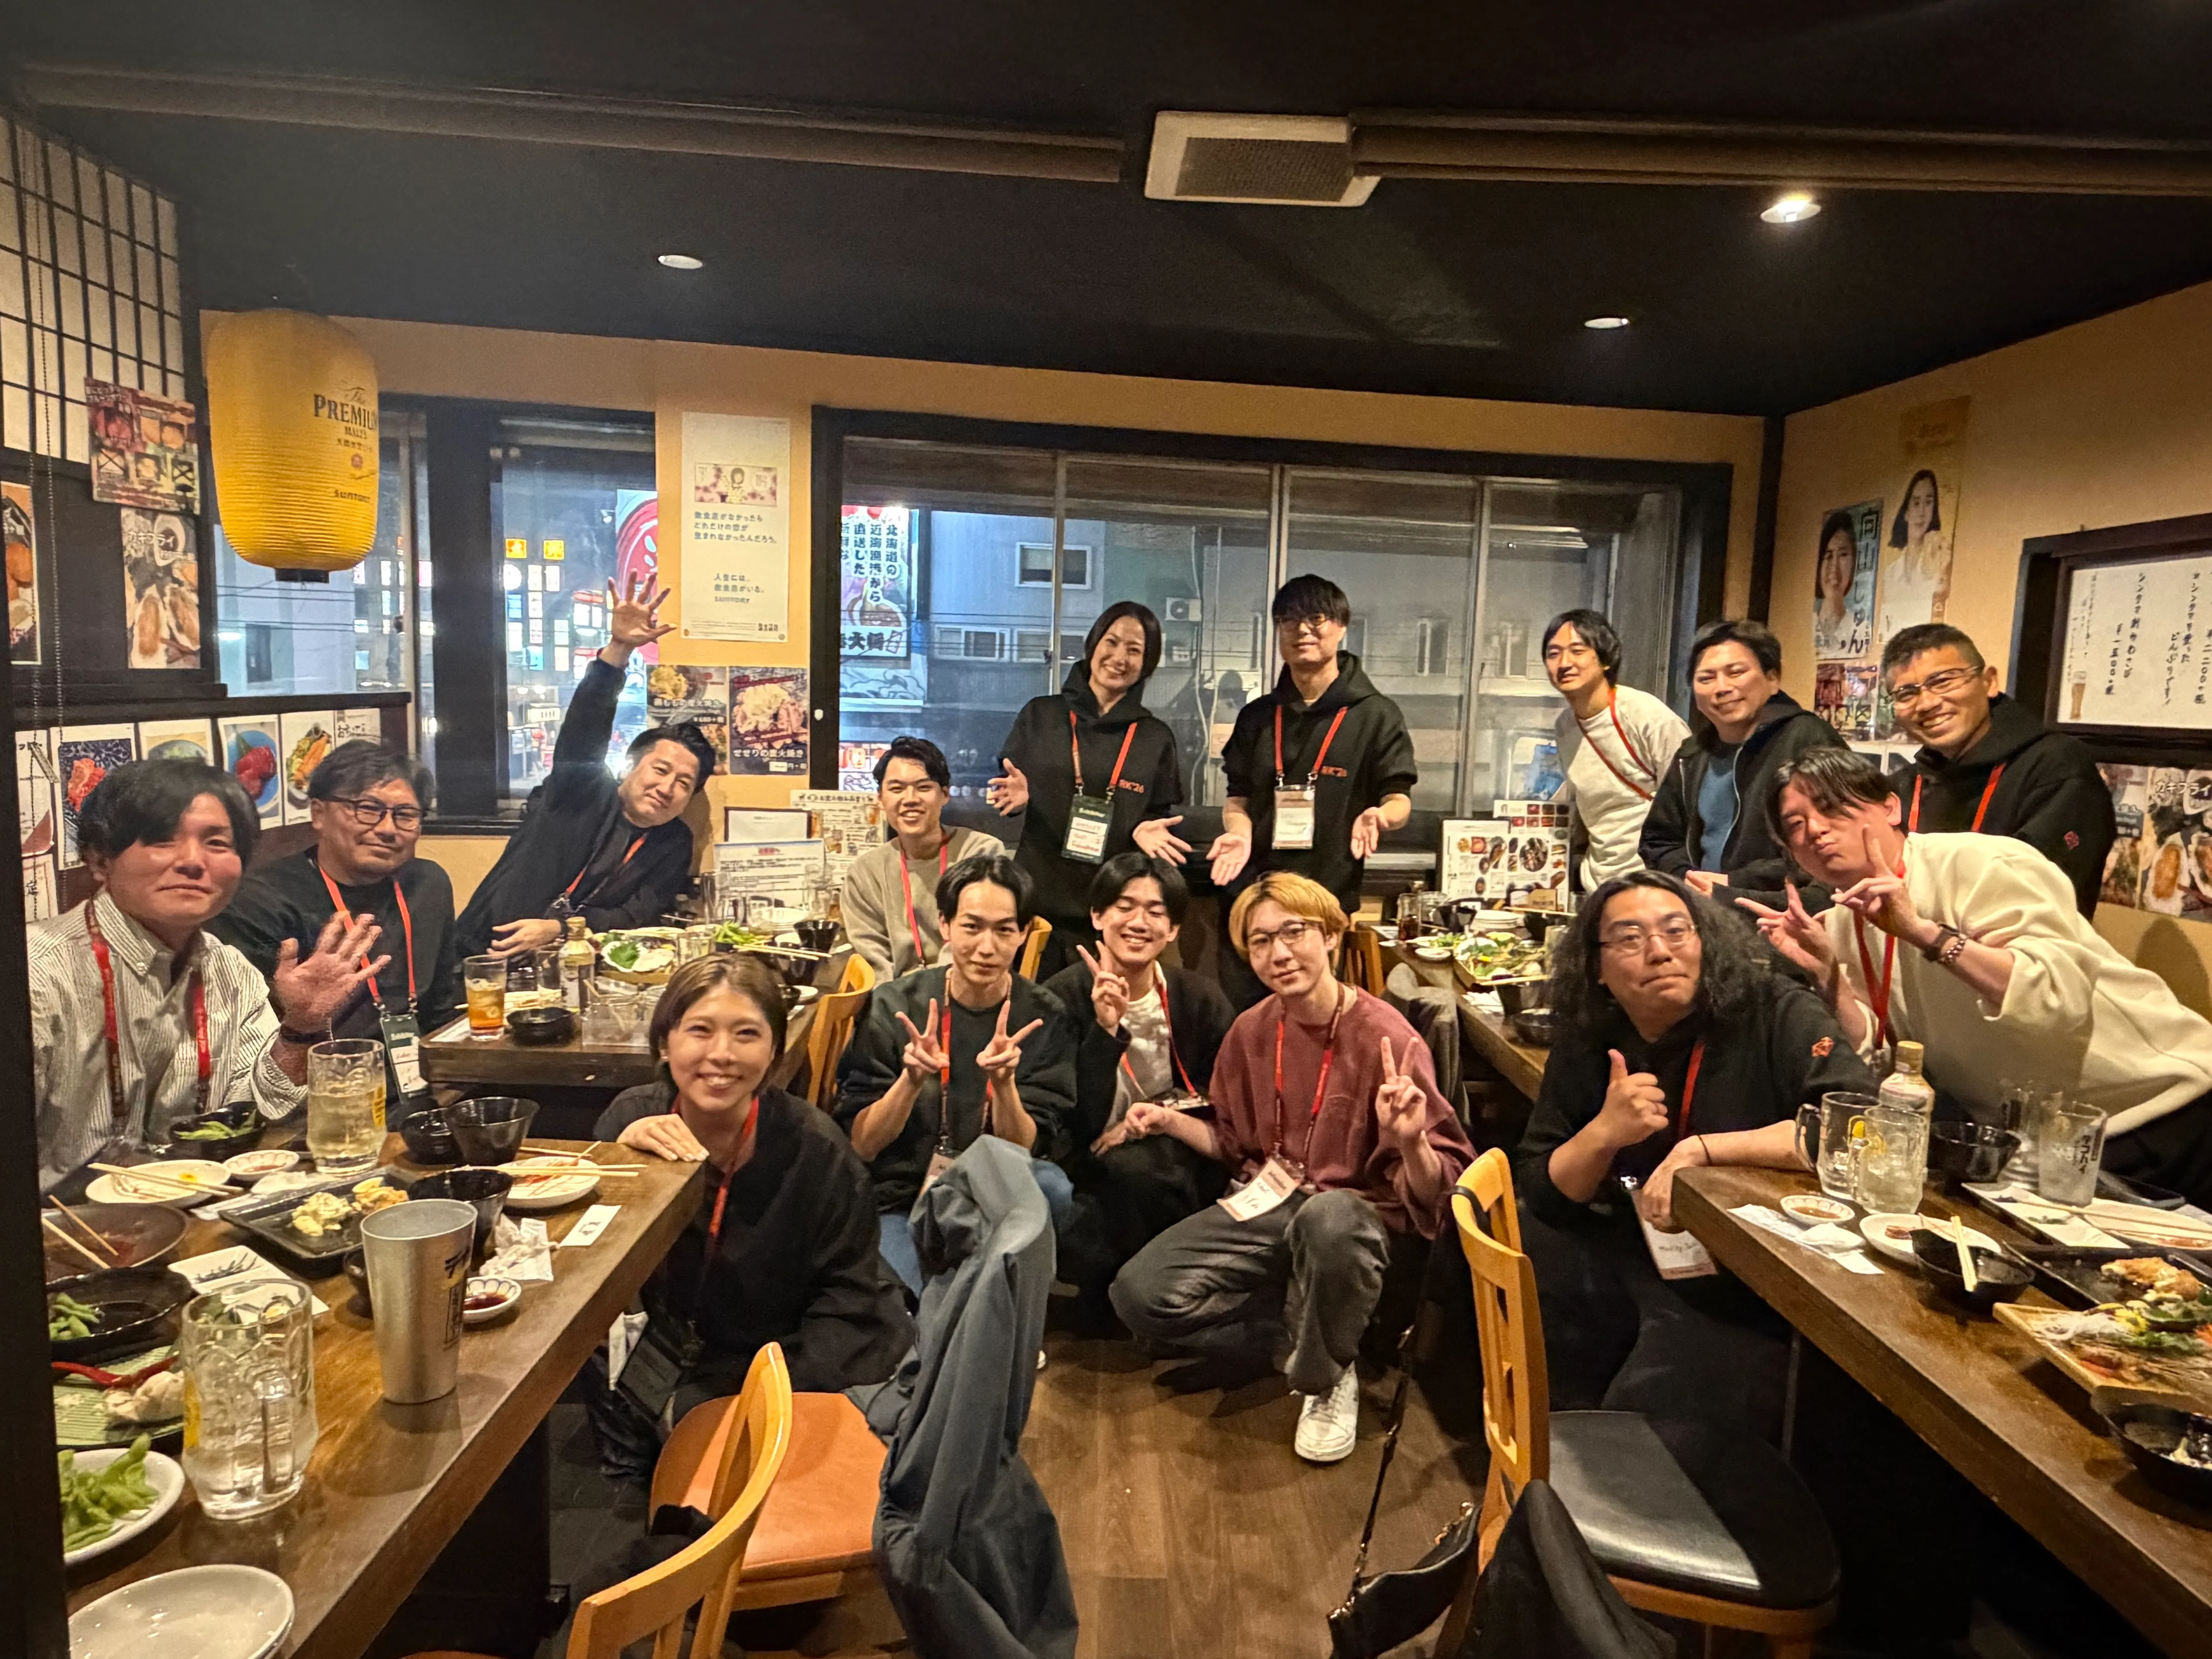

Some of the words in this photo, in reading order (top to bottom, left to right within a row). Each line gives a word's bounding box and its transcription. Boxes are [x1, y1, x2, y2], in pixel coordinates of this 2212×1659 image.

[854, 523, 866, 575] 直送した
[869, 524, 882, 602] 近海漁港から
[886, 524, 898, 575] 北海道の
